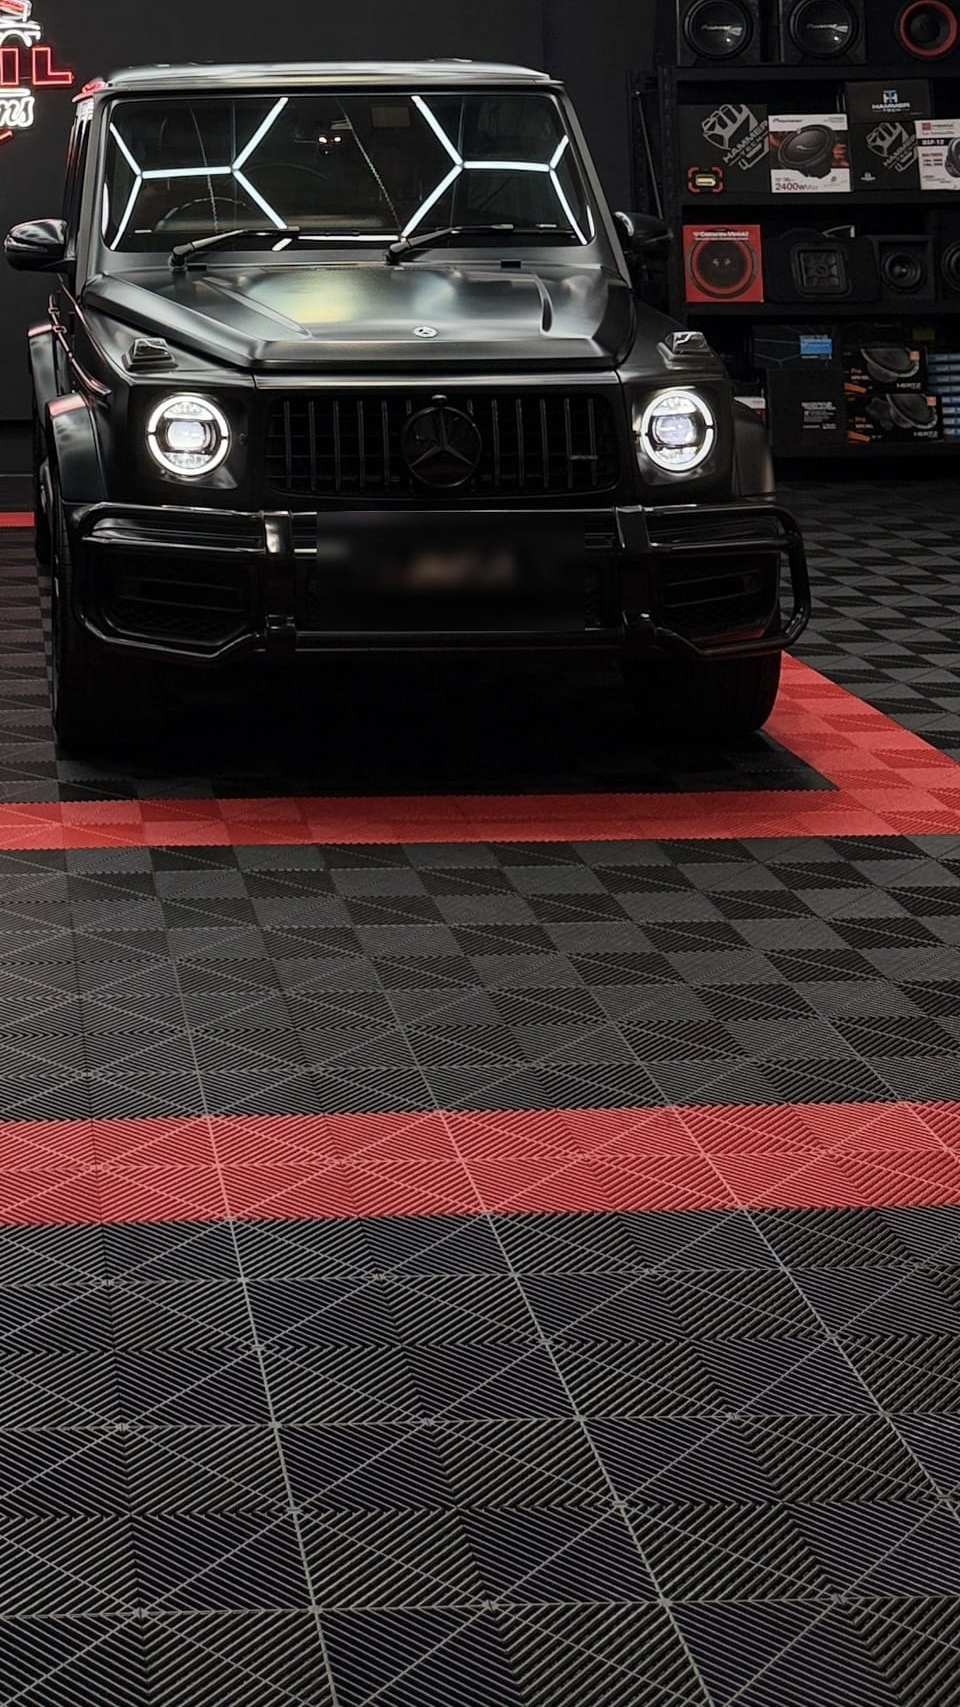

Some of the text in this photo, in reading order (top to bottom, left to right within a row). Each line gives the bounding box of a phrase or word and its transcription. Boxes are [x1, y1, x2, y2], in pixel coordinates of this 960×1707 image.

[721, 120, 769, 163] HAMMER
[895, 382, 922, 390] HERTZ
[912, 431, 939, 439] HERTZ
